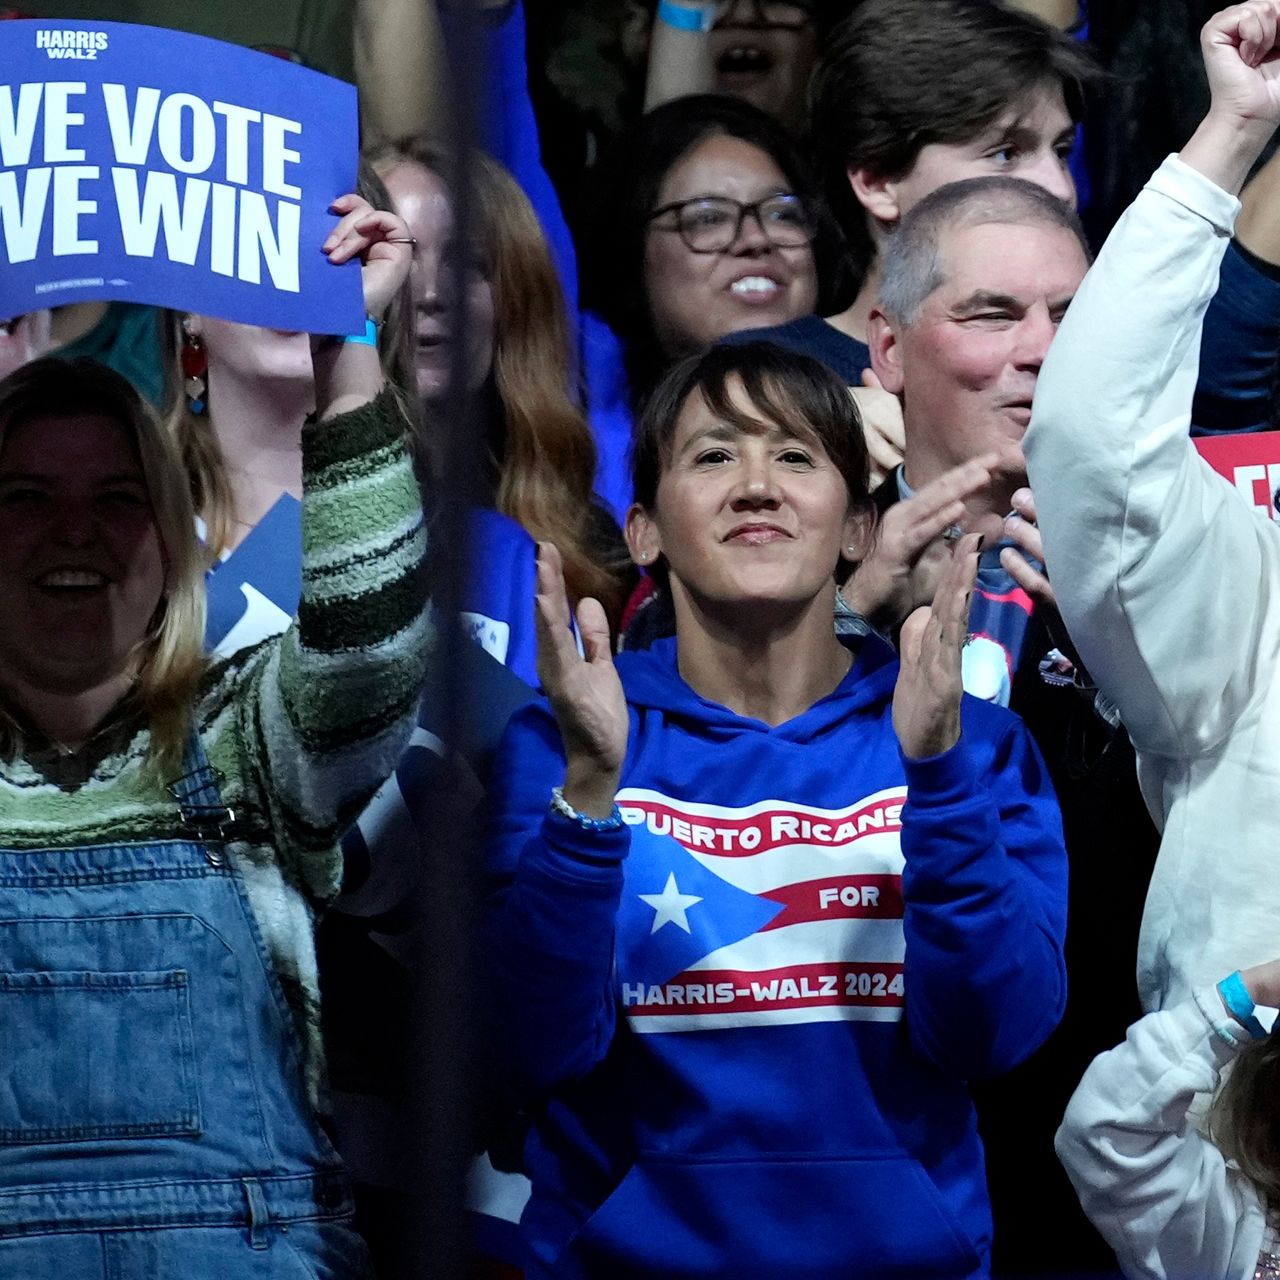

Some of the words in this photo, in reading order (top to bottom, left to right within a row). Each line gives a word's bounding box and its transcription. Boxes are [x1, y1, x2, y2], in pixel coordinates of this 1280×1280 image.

[36, 30, 108, 50] HARRIS
[46, 47, 97, 60] WALZ
[102, 82, 302, 200] VOTE
[111, 166, 301, 293] WIN
[620, 807, 763, 851] PUERTO
[770, 806, 903, 843] RICANS
[818, 886, 880, 910] FOR
[622, 975, 839, 1008] HARRIS-WALZ
[844, 973, 905, 997] 2024
